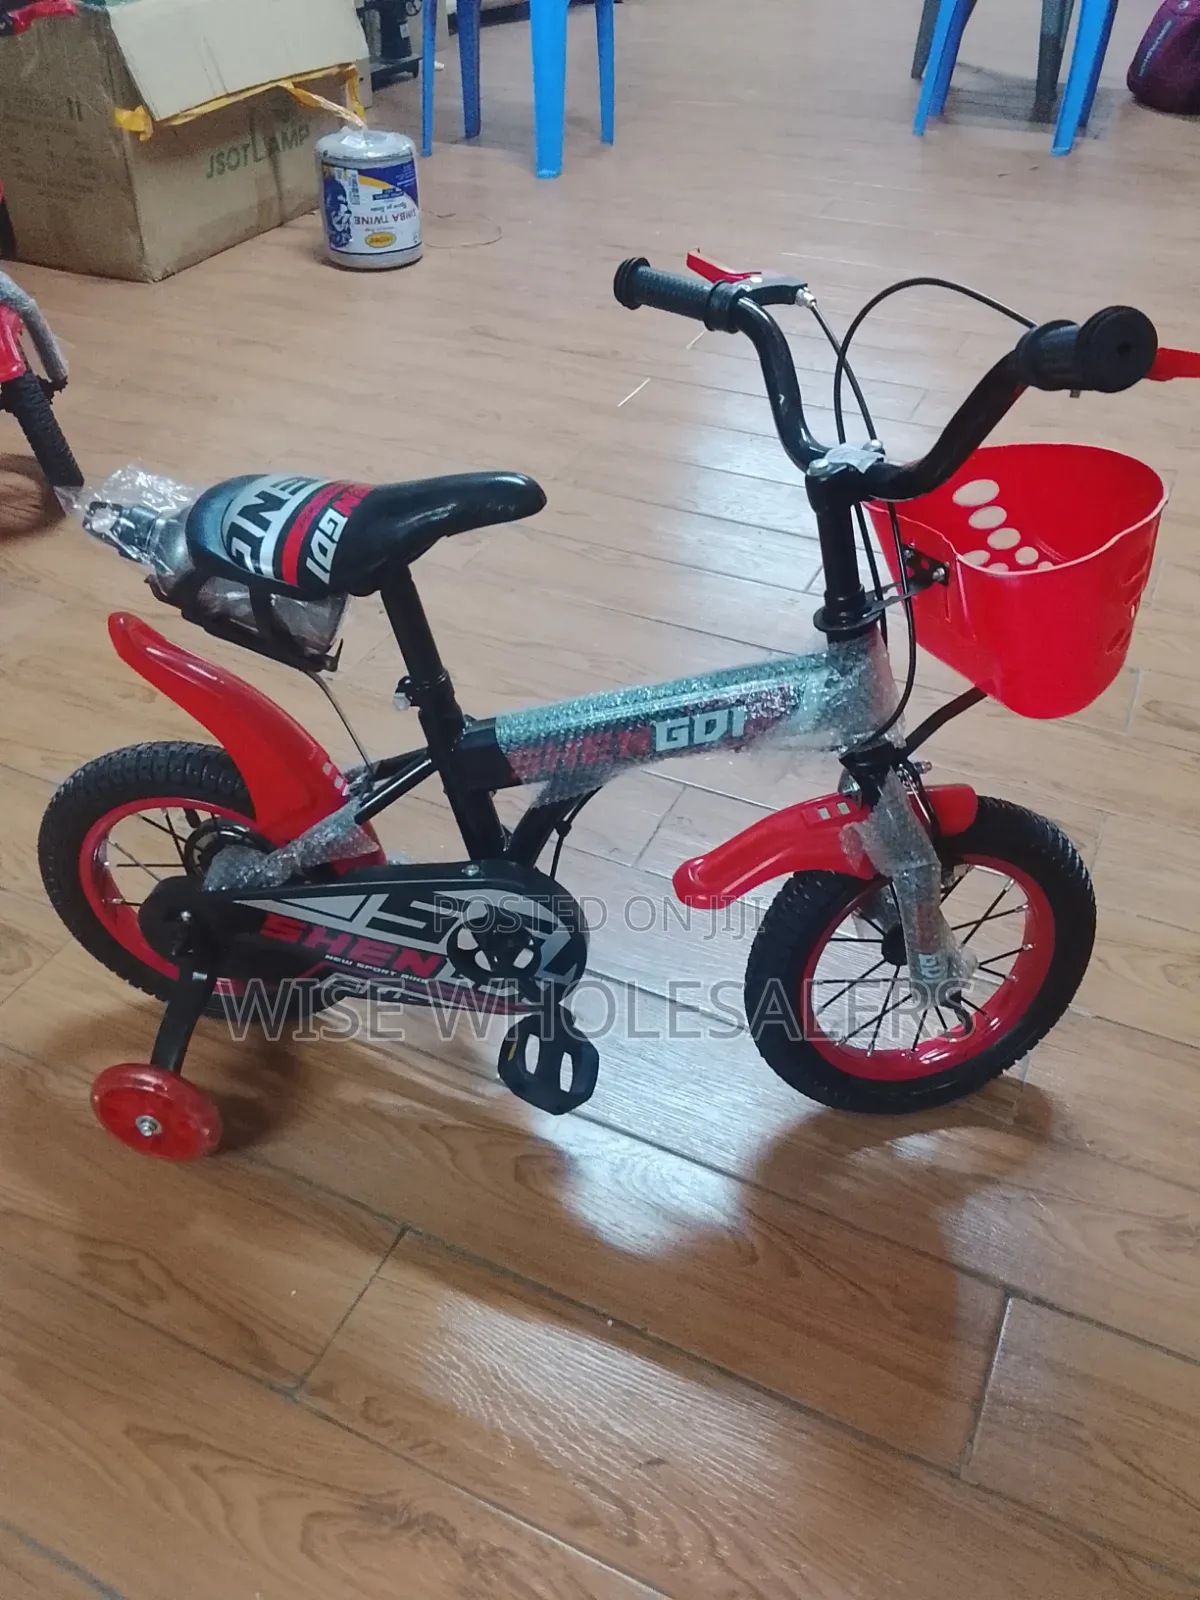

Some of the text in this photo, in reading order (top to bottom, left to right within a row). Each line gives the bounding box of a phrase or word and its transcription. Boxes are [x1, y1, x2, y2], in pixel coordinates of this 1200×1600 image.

[354, 215, 389, 225] TWINE
[260, 912, 442, 977] SHEN
[324, 954, 353, 966] NEW
[356, 962, 398, 975] SPORT
